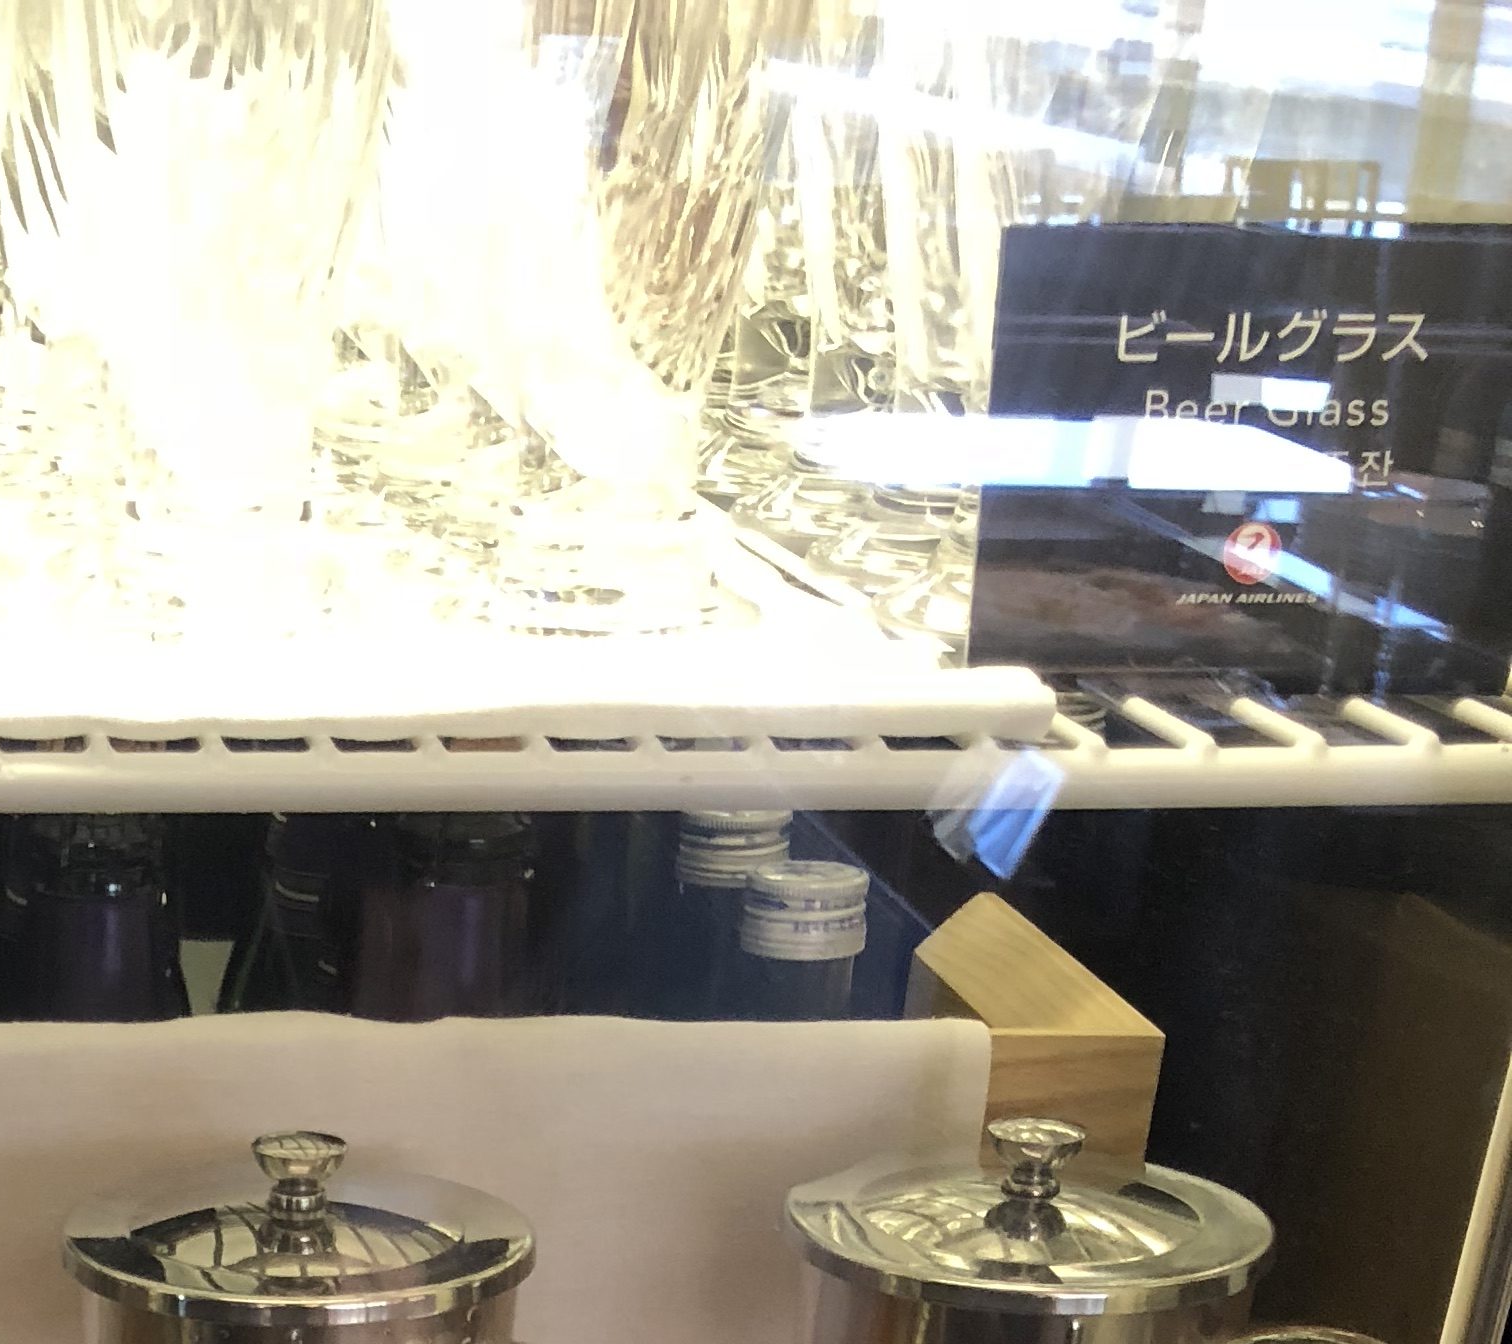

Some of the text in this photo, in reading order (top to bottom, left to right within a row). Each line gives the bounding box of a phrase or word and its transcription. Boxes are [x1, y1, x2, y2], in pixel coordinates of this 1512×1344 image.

[1116, 309, 1429, 363] ビールグラス
[1175, 591, 1318, 606] JAPAN AIRLINES
